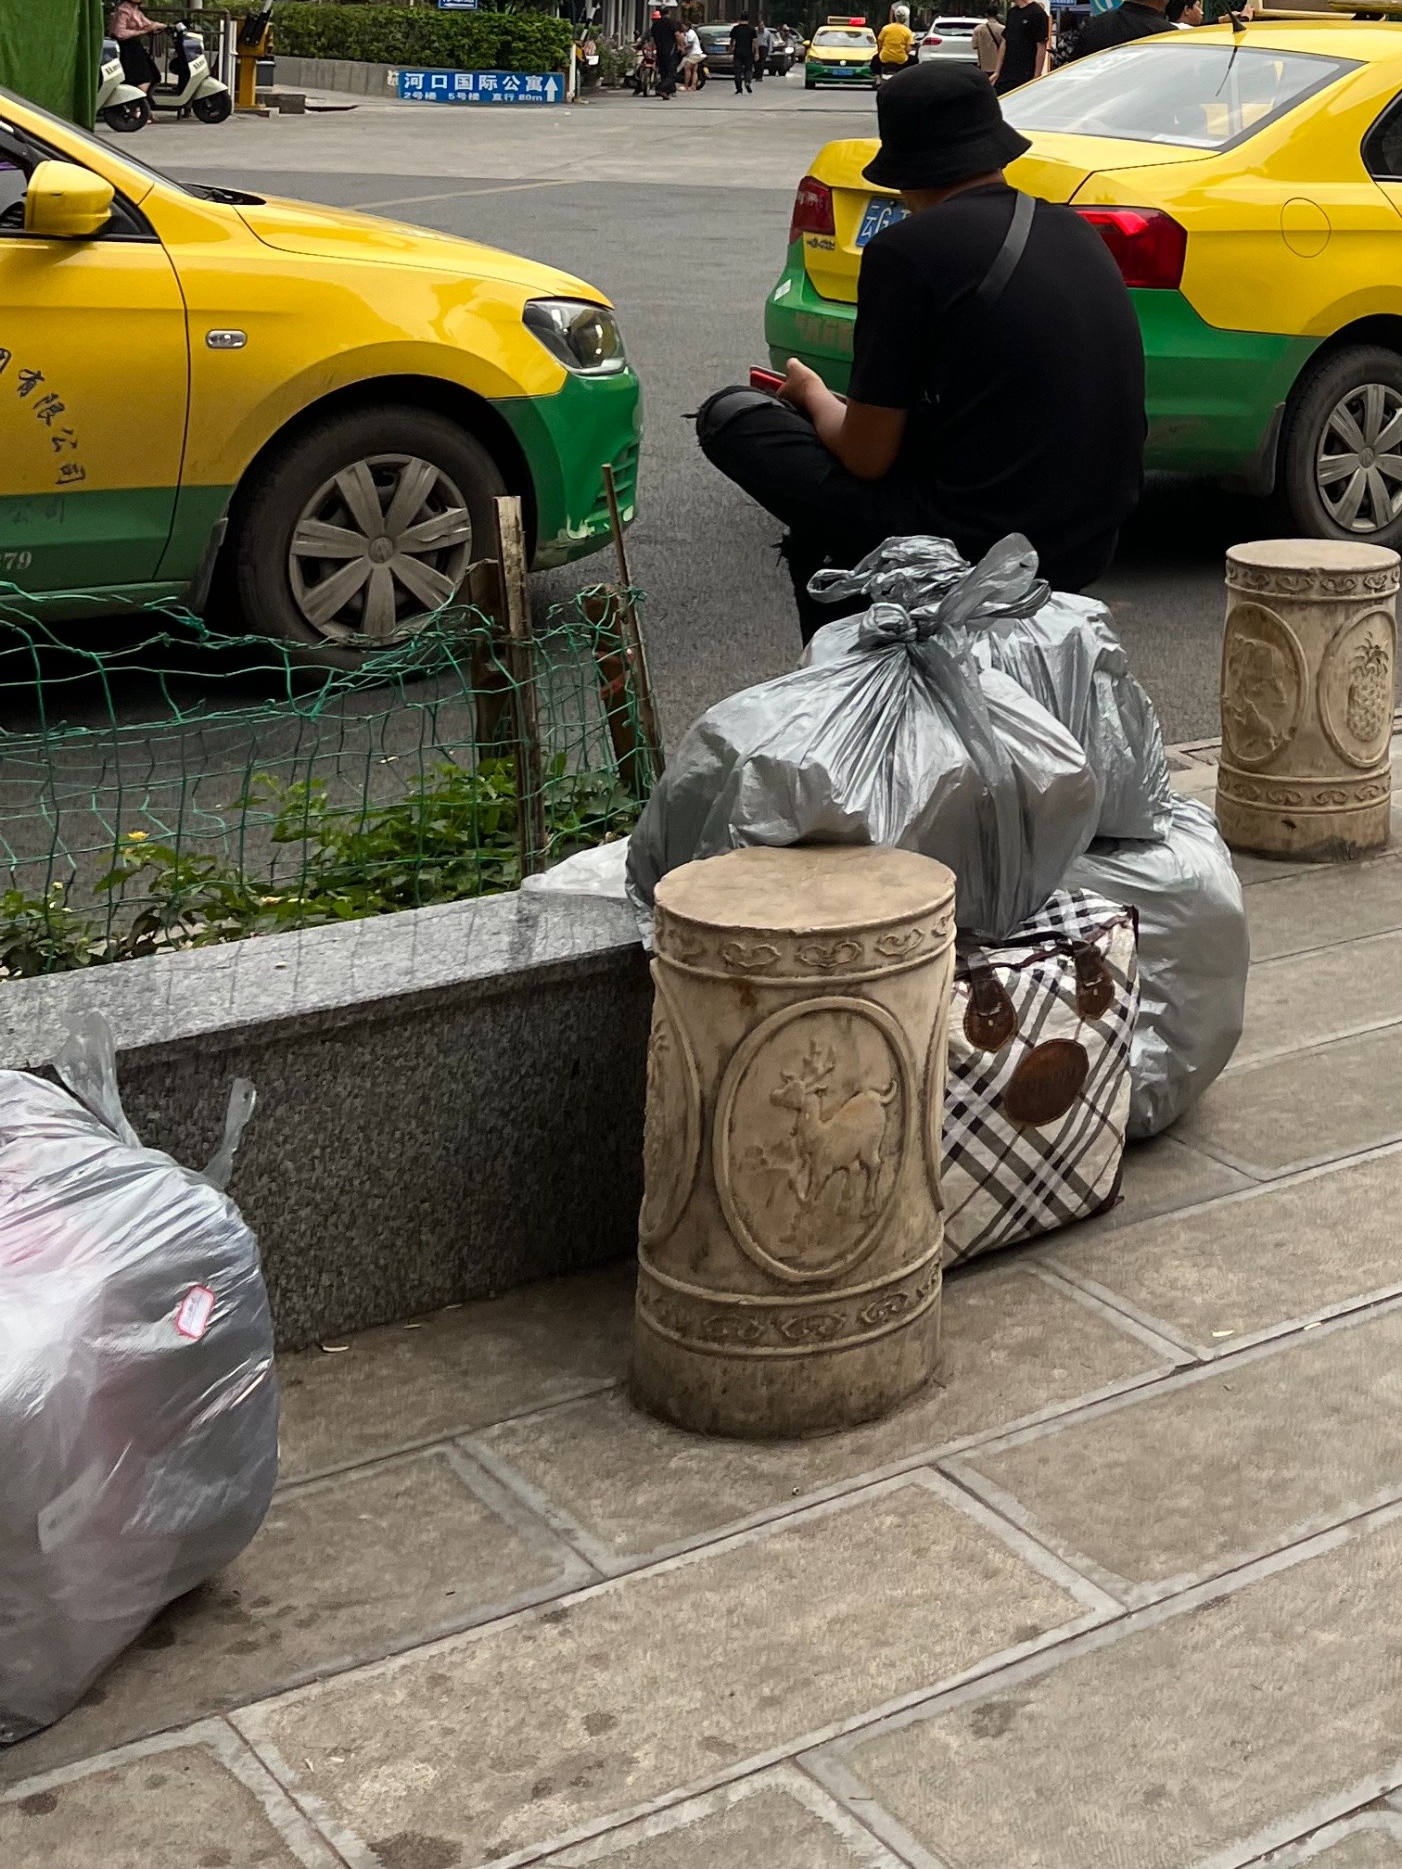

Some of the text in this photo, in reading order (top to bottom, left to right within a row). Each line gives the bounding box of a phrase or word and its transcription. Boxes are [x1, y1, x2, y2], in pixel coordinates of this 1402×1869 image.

[404, 72, 544, 92] 河口国际公寓
[0, 551, 33, 571] 79
